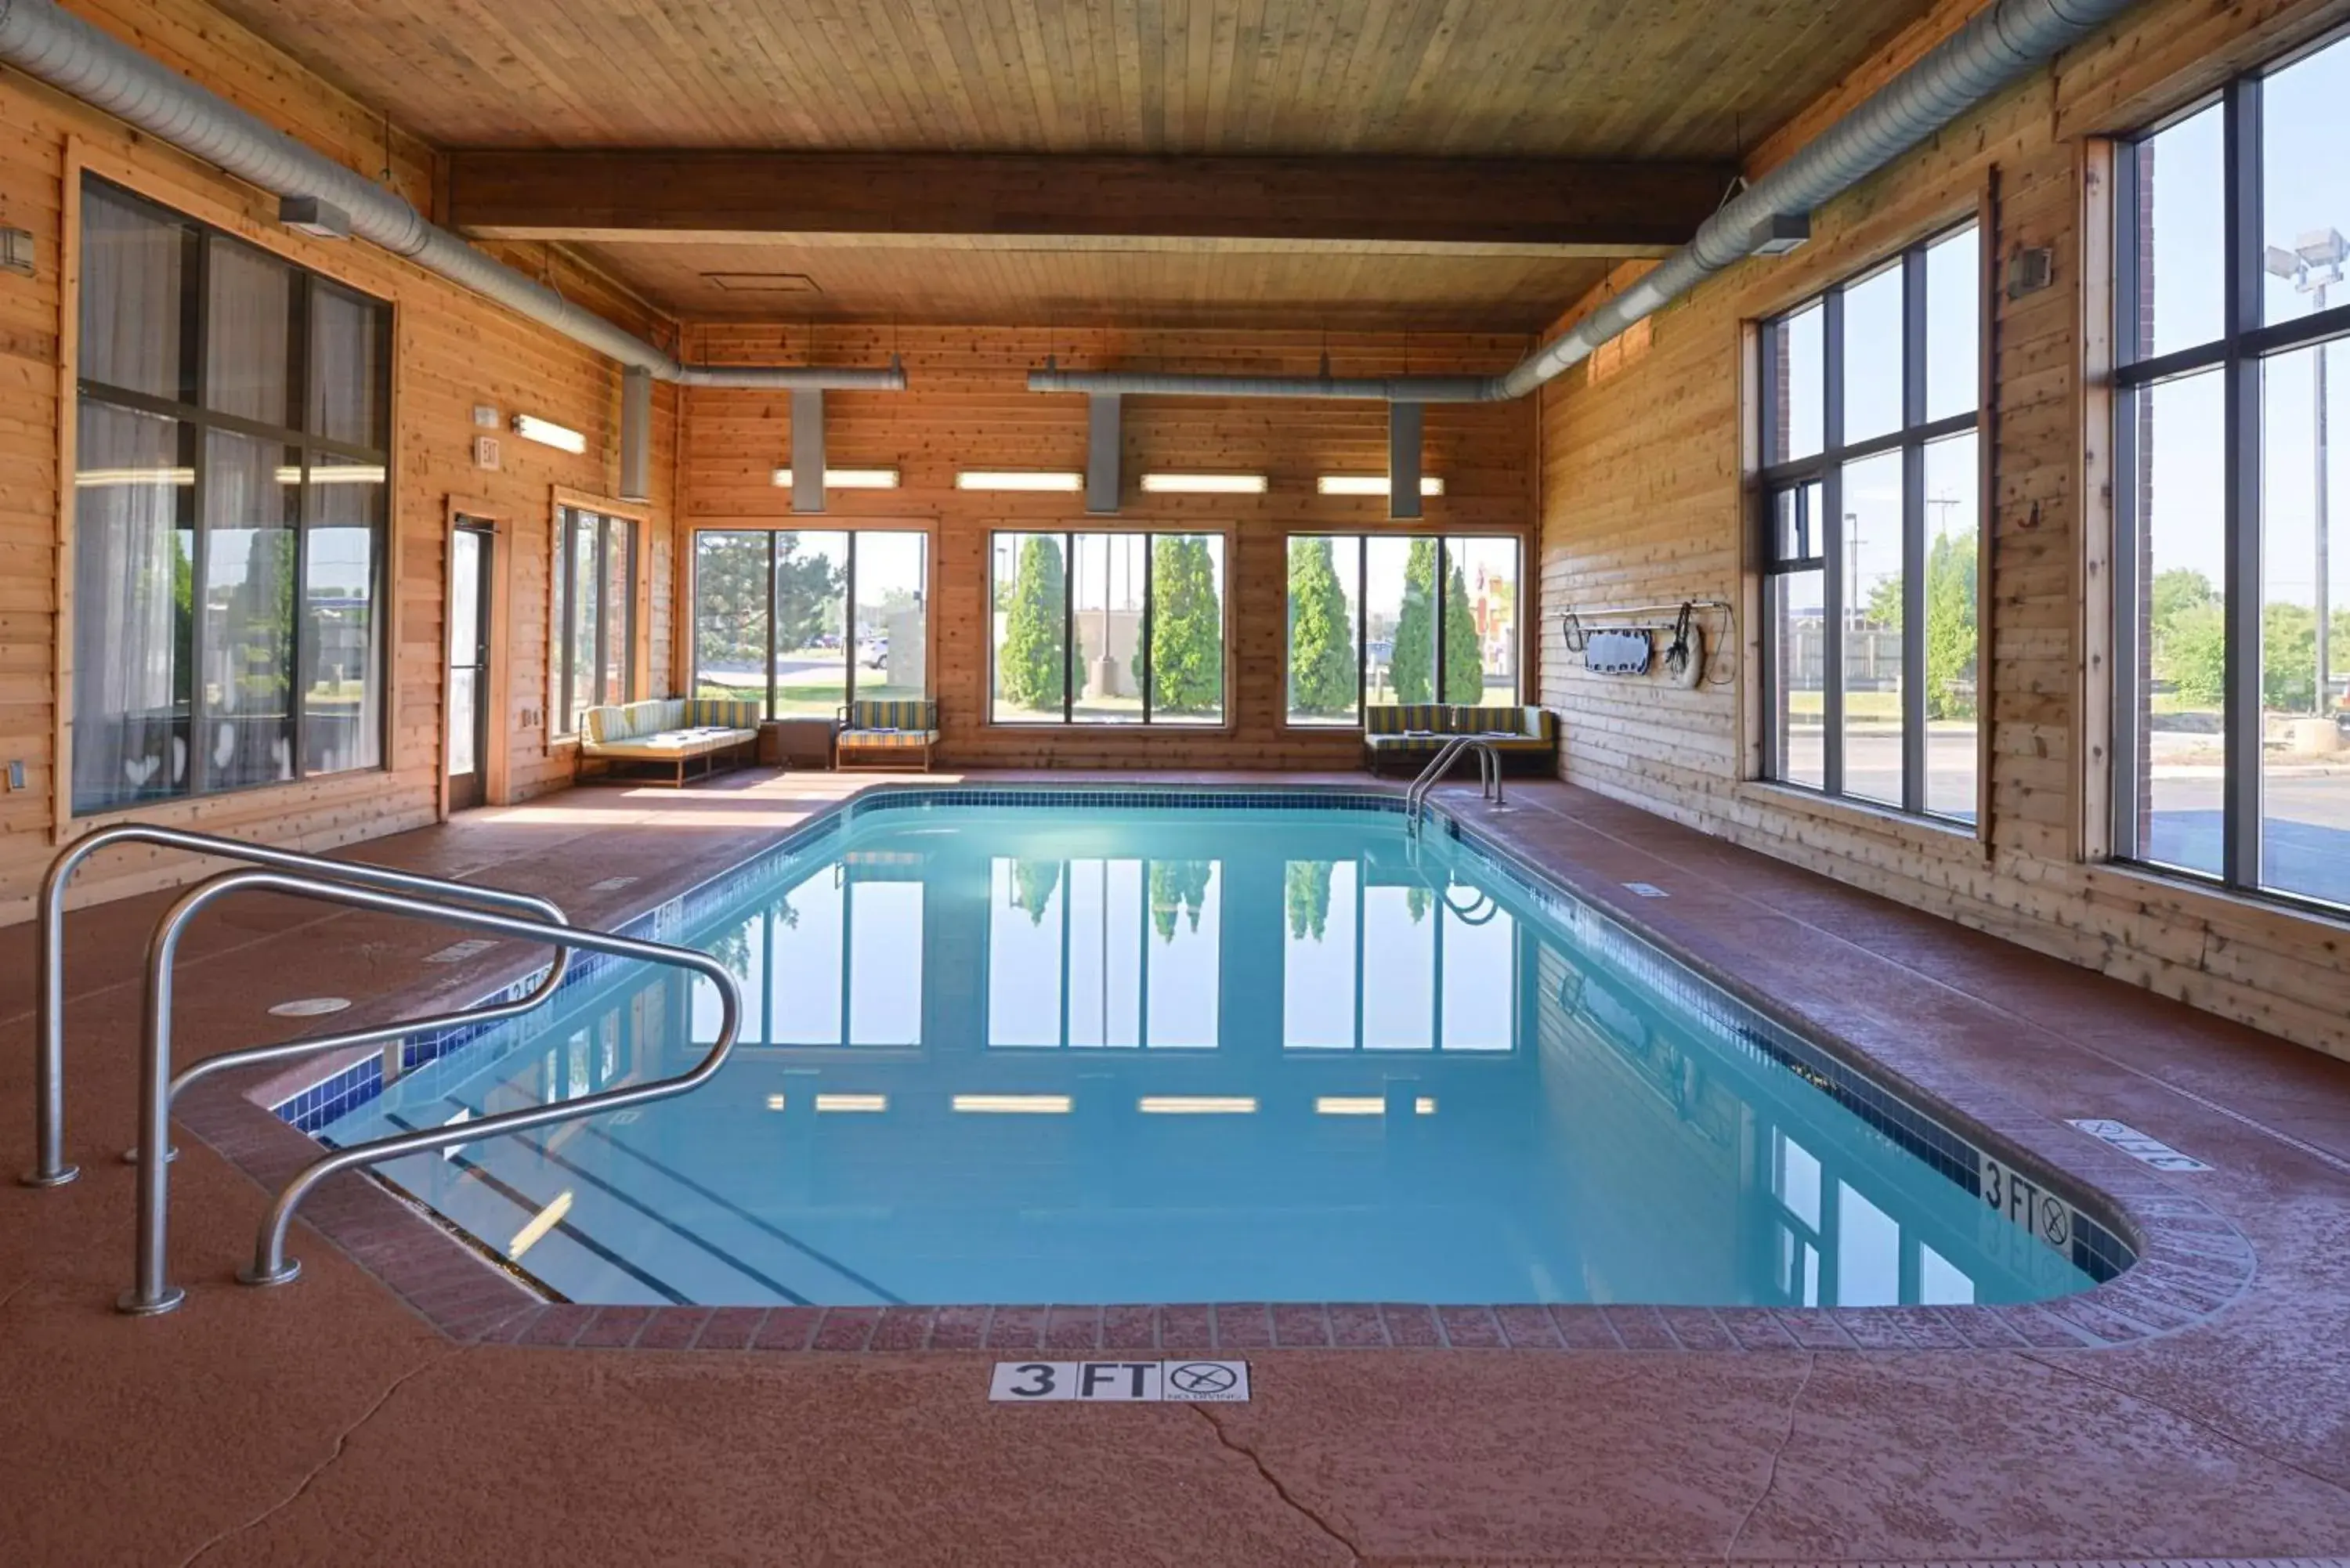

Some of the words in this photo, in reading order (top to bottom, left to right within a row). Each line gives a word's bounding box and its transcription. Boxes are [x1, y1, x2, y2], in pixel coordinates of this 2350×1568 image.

[1986, 1161, 2001, 1210] 3
[2010, 1173, 2037, 1235] FT
[1010, 1364, 1055, 1396] 3
[1082, 1363, 1157, 1397] FT
